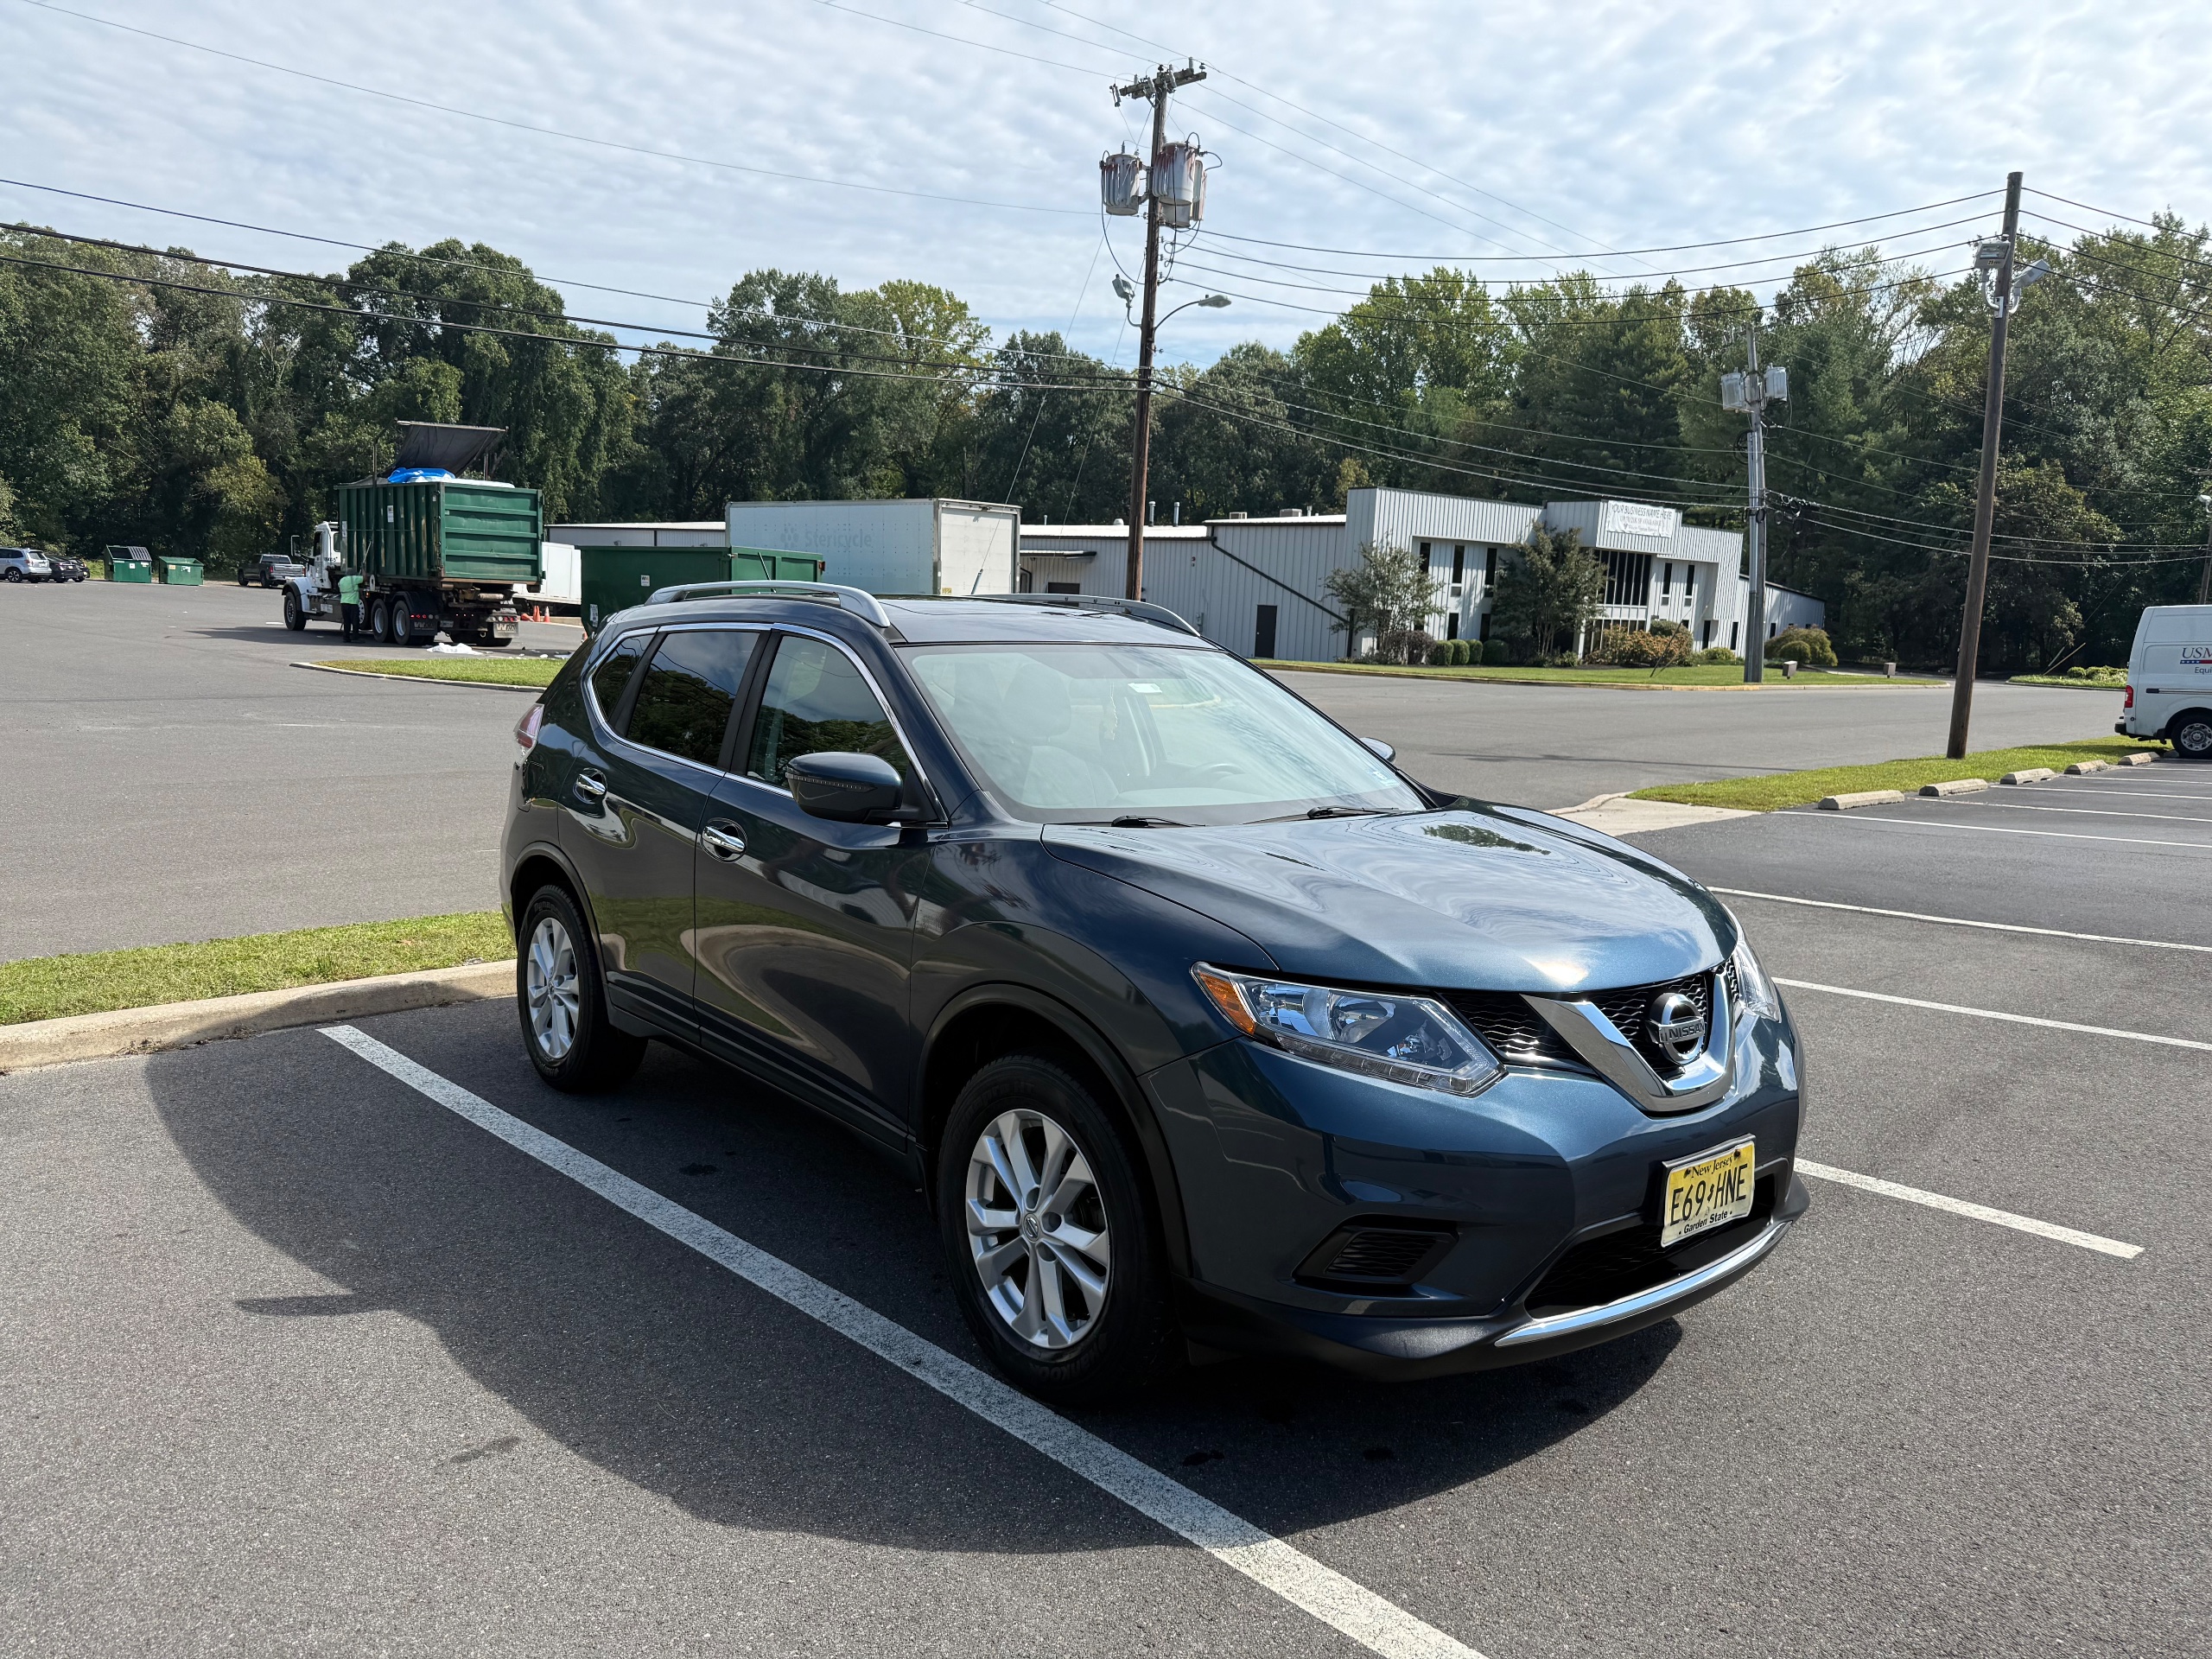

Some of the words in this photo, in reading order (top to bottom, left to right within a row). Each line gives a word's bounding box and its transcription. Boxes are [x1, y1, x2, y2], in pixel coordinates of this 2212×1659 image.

[1612, 504, 1624, 513] YOUR
[1624, 505, 1646, 517] BUSINESS
[1646, 508, 1660, 518] NAME
[1660, 510, 1672, 520] HERE
[805, 530, 872, 550] Stericycle
[1669, 1022, 1704, 1039] NISSAN
[1691, 1164, 1711, 1178] New
[1712, 1154, 1733, 1174] Jersey
[1684, 1219, 1707, 1234] Garden
[1709, 1210, 1728, 1224] State
